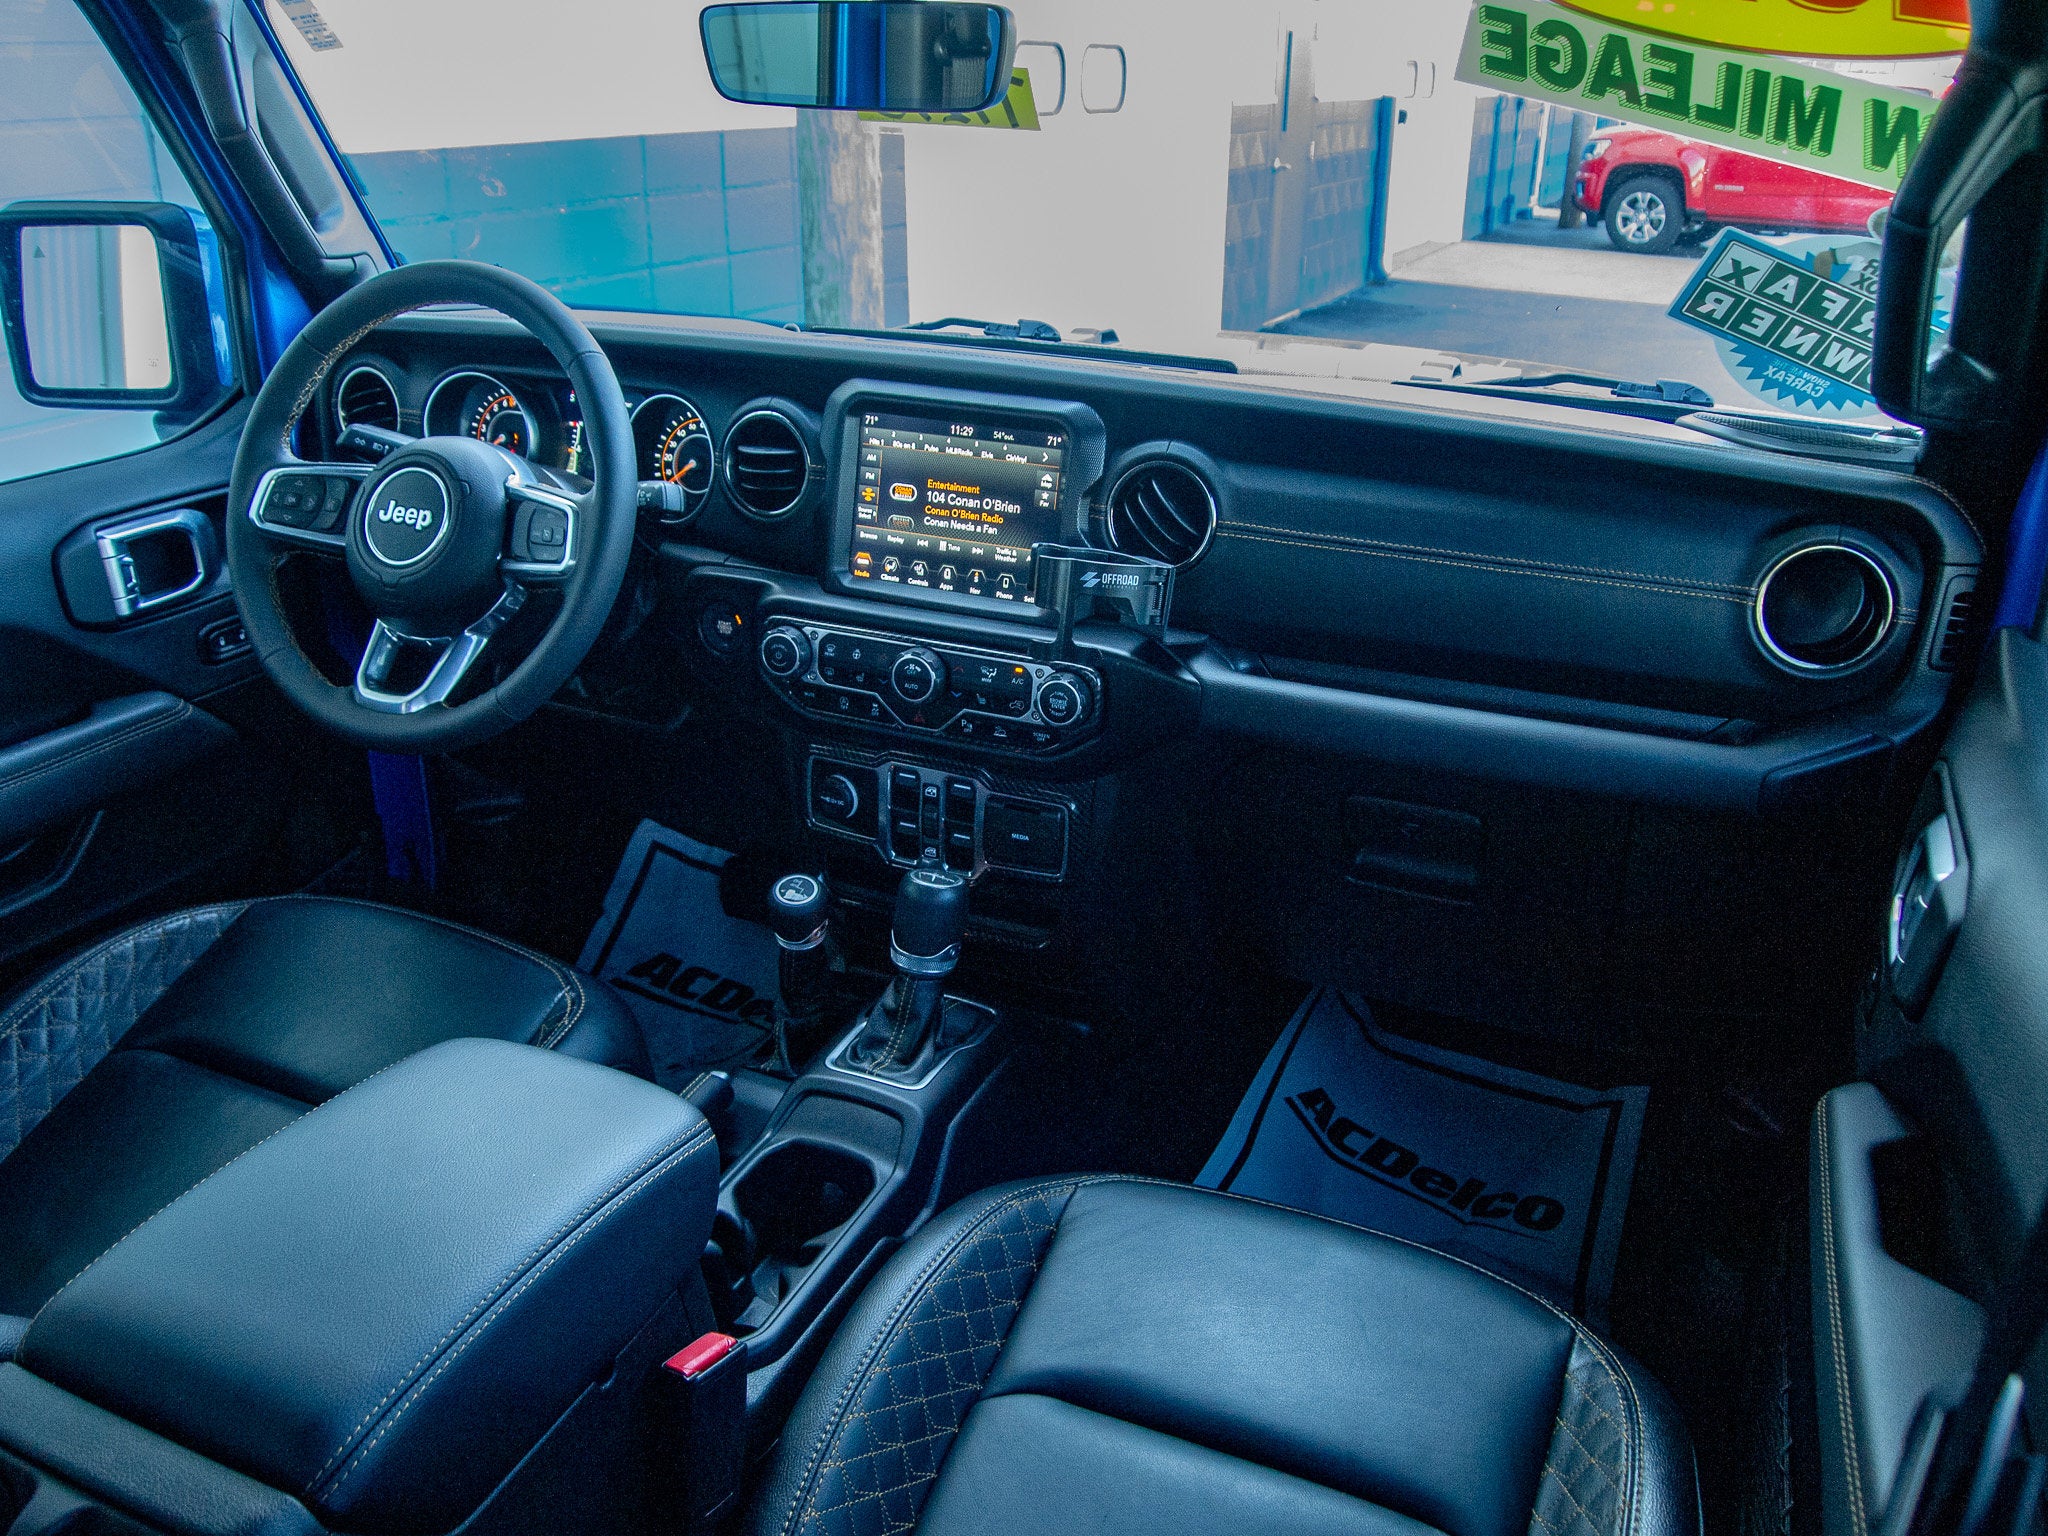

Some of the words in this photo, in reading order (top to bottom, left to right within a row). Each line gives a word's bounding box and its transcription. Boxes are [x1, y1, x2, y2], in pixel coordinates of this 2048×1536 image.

[950, 424, 974, 436] 11:29
[664, 453, 673, 461] 20
[866, 454, 877, 462] AM
[927, 479, 980, 494] Entertainment
[927, 490, 946, 504] 104
[947, 493, 980, 508] Conan
[982, 498, 1021, 514] O'Brien
[378, 500, 433, 531] Jeep
[924, 505, 950, 517] Conan
[951, 509, 980, 521] O'Brien
[981, 512, 1004, 524] Radio
[923, 516, 949, 528] Conan
[950, 519, 975, 532] Needs
[976, 525, 982, 533] a
[982, 524, 998, 535] Fan
[854, 569, 870, 578] Media
[907, 577, 929, 587] Controls
[1101, 573, 1139, 586] OFFROAD
[939, 582, 954, 591] Apps
[995, 590, 1014, 600] Phone
[1011, 677, 1024, 685] A/C
[1011, 833, 1030, 841] MEDIA
[1296, 1087, 1565, 1231] ACDelco
